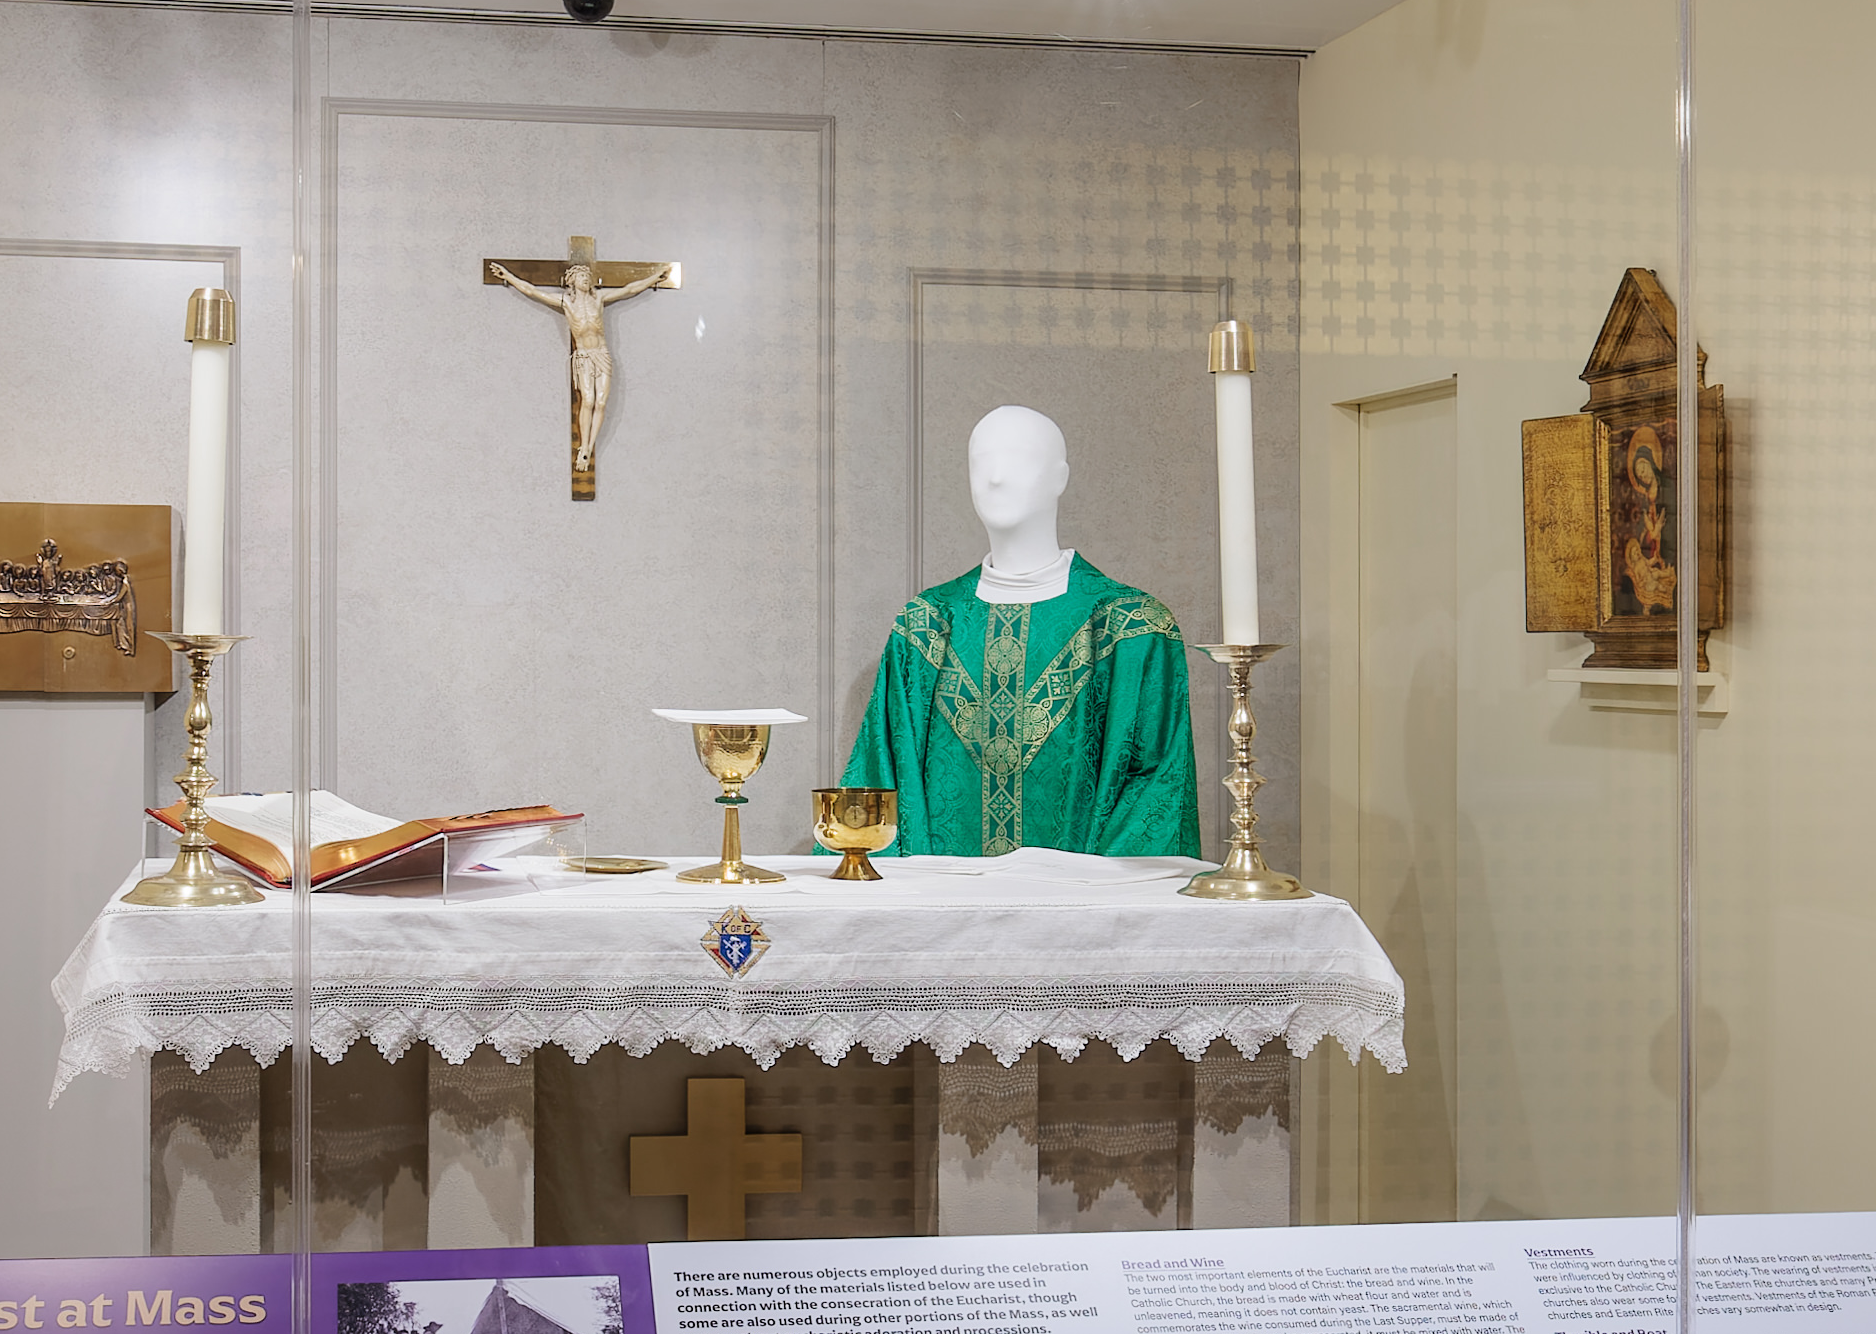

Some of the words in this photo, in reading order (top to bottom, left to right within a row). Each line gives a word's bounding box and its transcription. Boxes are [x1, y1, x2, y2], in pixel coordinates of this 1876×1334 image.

[721, 925, 729, 933] K
[744, 925, 751, 933] C
[1524, 1246, 1594, 1257] Vestments
[674, 1271, 714, 1282] There
[717, 1272, 739, 1281] are
[743, 1271, 813, 1280] numerous
[816, 1267, 867, 1281] objects
[870, 1265, 937, 1279] employed
[940, 1264, 984, 1278] during
[987, 1263, 1009, 1274] the
[1012, 1261, 1089, 1273] celebration
[1121, 1259, 1161, 1270] Bread
[1163, 1258, 1188, 1269] and
[1190, 1257, 1224, 1268] Wine
[676, 1286, 689, 1297] of
[693, 1285, 733, 1297] Mass.
[736, 1284, 773, 1298] Many
[777, 1284, 790, 1294] of
[794, 1283, 817, 1294] the
[820, 1281, 884, 1293] materials
[887, 1280, 925, 1292] listed
[928, 1279, 970, 1290] below
[973, 1281, 995, 1289] are
[998, 1277, 1030, 1289] used
[1033, 1277, 1046, 1288] in
[56, 1293, 112, 1327] at
[125, 1289, 267, 1327] Mass
[678, 1300, 756, 1313] connection
[759, 1299, 791, 1310] with
[794, 1299, 817, 1310] the
[820, 1296, 910, 1309] consecration
[913, 1296, 927, 1306] of
[930, 1295, 953, 1306] the
[956, 1293, 1025, 1307] Eucharist,
[1028, 1292, 1077, 1306] though
